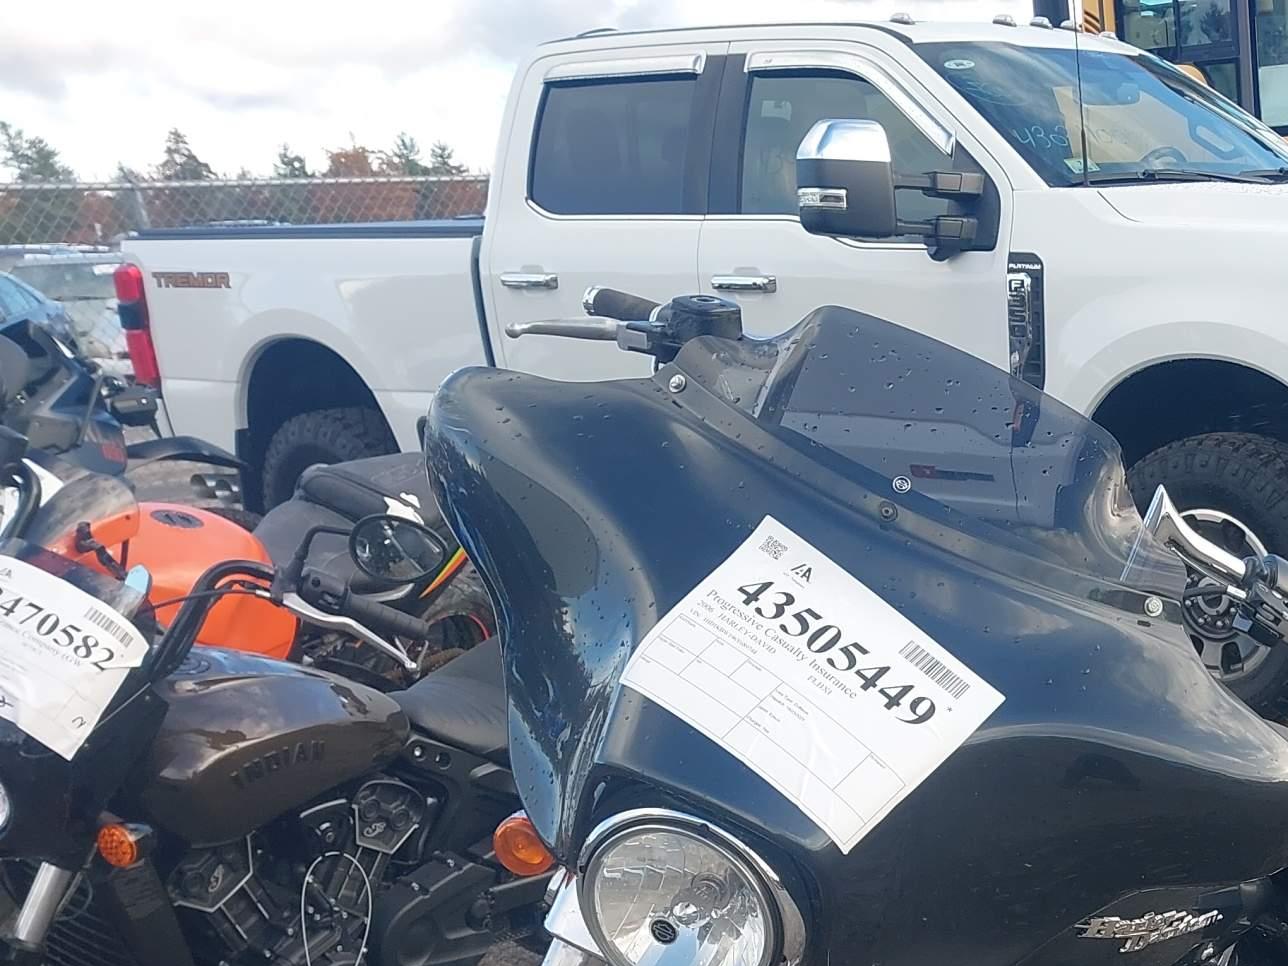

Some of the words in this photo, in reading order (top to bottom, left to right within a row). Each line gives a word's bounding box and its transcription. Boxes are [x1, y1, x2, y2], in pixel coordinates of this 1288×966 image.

[151, 271, 232, 289] TREMOR
[0, 587, 115, 672] 470582
[706, 588, 764, 631] Progressive
[764, 627, 809, 663] Casualty
[808, 658, 858, 699] Insurance
[717, 612, 777, 655] HARLEY-DAVID
[736, 580, 937, 725] 43505449
